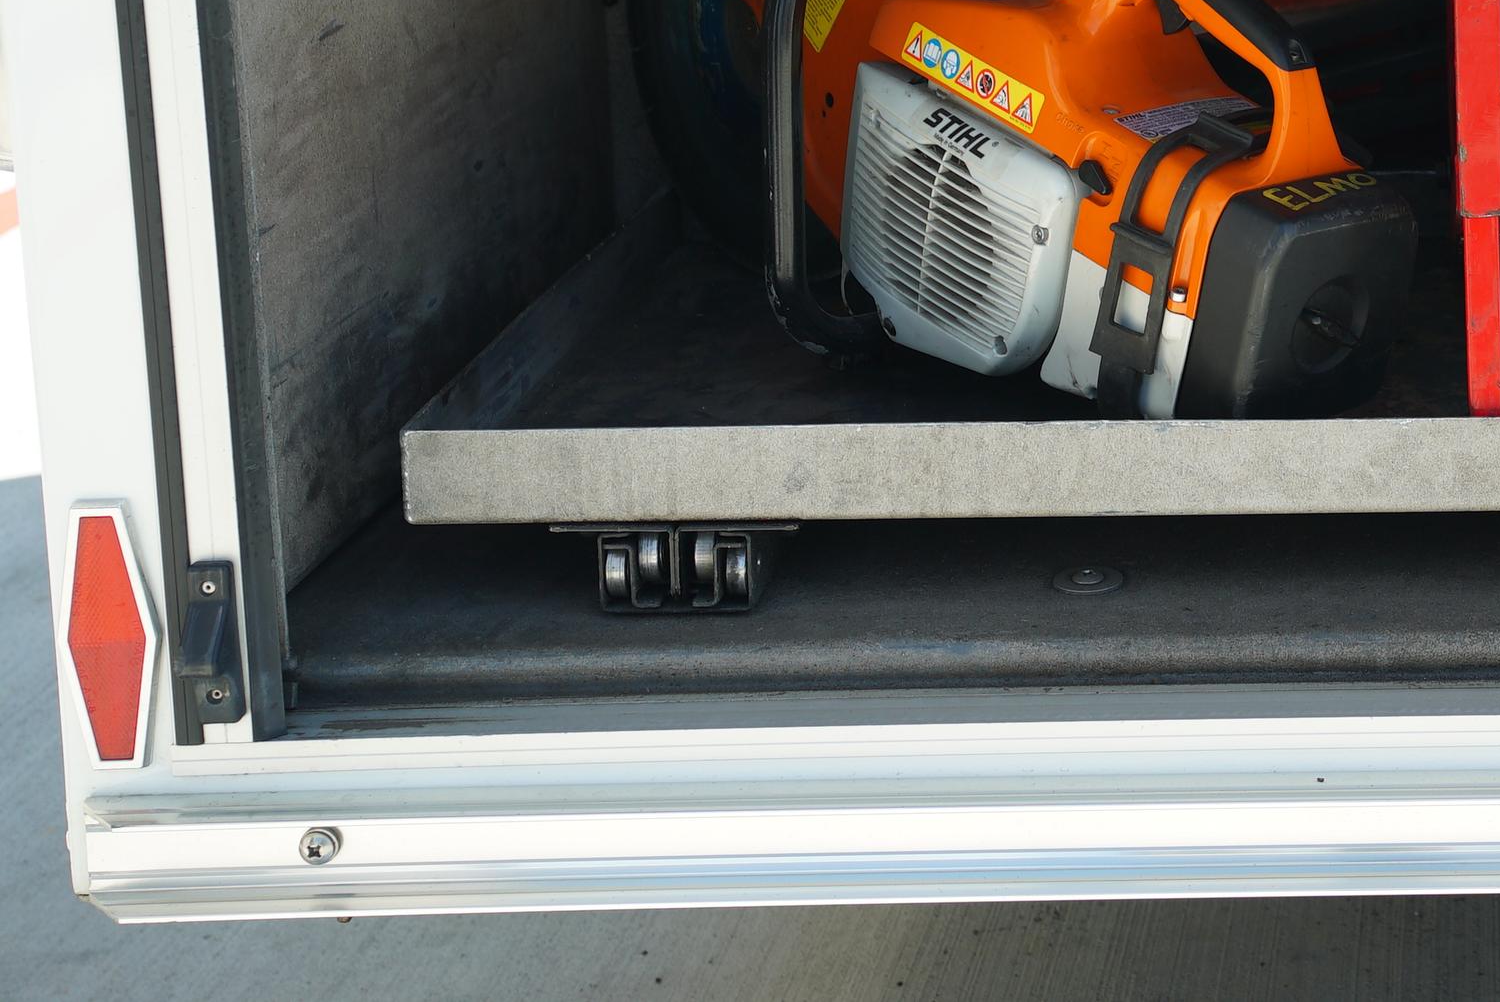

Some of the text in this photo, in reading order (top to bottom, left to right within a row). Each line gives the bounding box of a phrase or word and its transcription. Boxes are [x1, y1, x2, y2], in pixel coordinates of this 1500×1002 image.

[923, 107, 991, 159] STIHL
[1117, 113, 1146, 123] STIHL
[1263, 173, 1377, 211] ELMO
